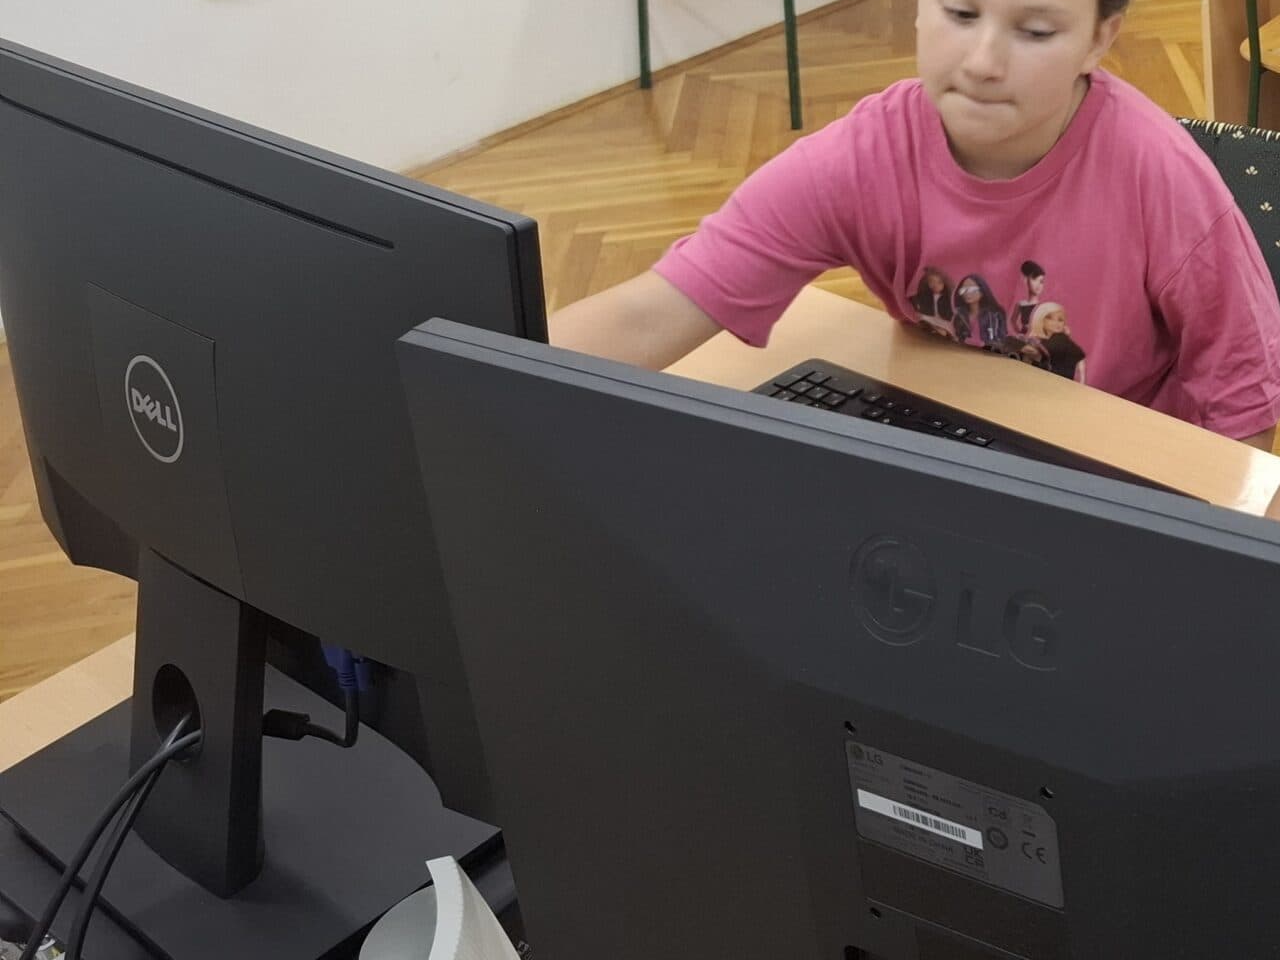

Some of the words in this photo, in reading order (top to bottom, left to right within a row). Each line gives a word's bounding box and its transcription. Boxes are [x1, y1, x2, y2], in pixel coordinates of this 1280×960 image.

[131, 387, 177, 432] DELL
[956, 570, 1062, 671] LG
[867, 752, 884, 766] LG
